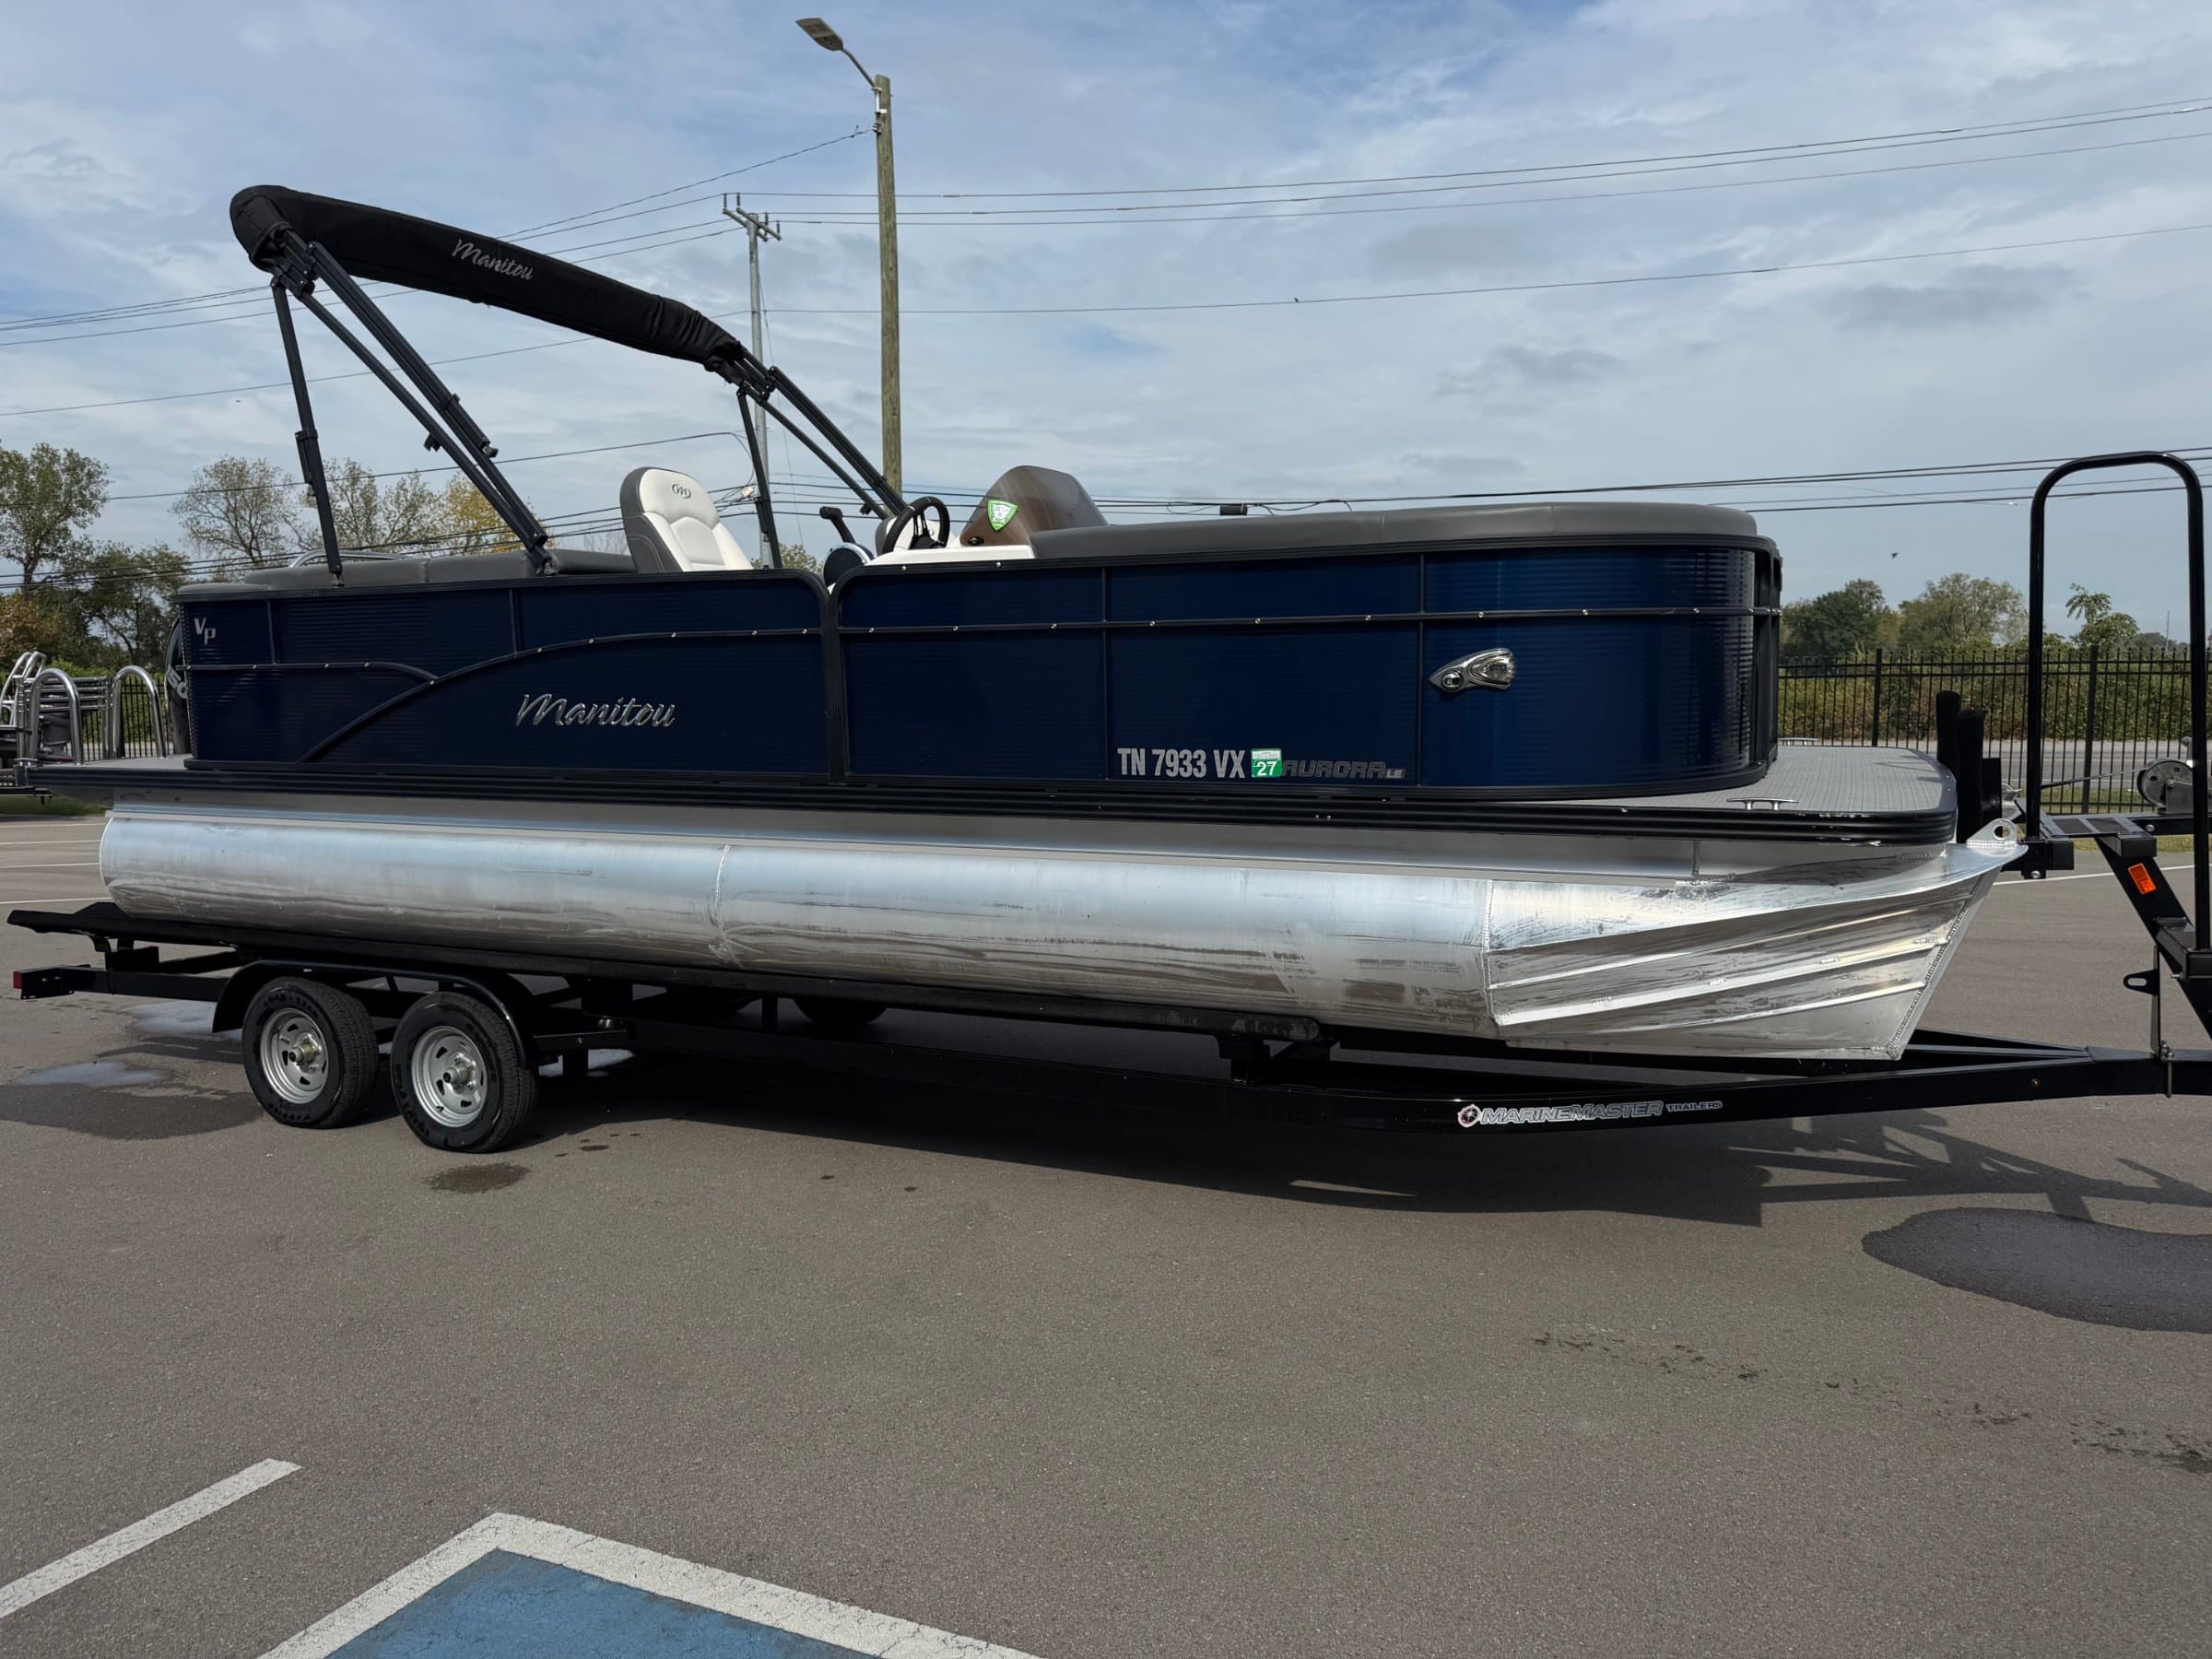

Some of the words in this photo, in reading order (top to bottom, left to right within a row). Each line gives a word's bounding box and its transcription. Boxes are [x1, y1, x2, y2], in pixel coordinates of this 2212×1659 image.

[452, 239, 534, 280] Manitou
[516, 693, 676, 727] Manitou
[1117, 747, 1146, 776] TN
[1152, 749, 1206, 778] 7933
[1213, 749, 1246, 779] VX
[1256, 760, 1277, 776] 27
[1282, 759, 1386, 778] AURORA
[1385, 768, 1405, 779] LE
[1480, 1100, 1664, 1124] MARINEMASTER
[1665, 1100, 1723, 1112] TRAILERS
